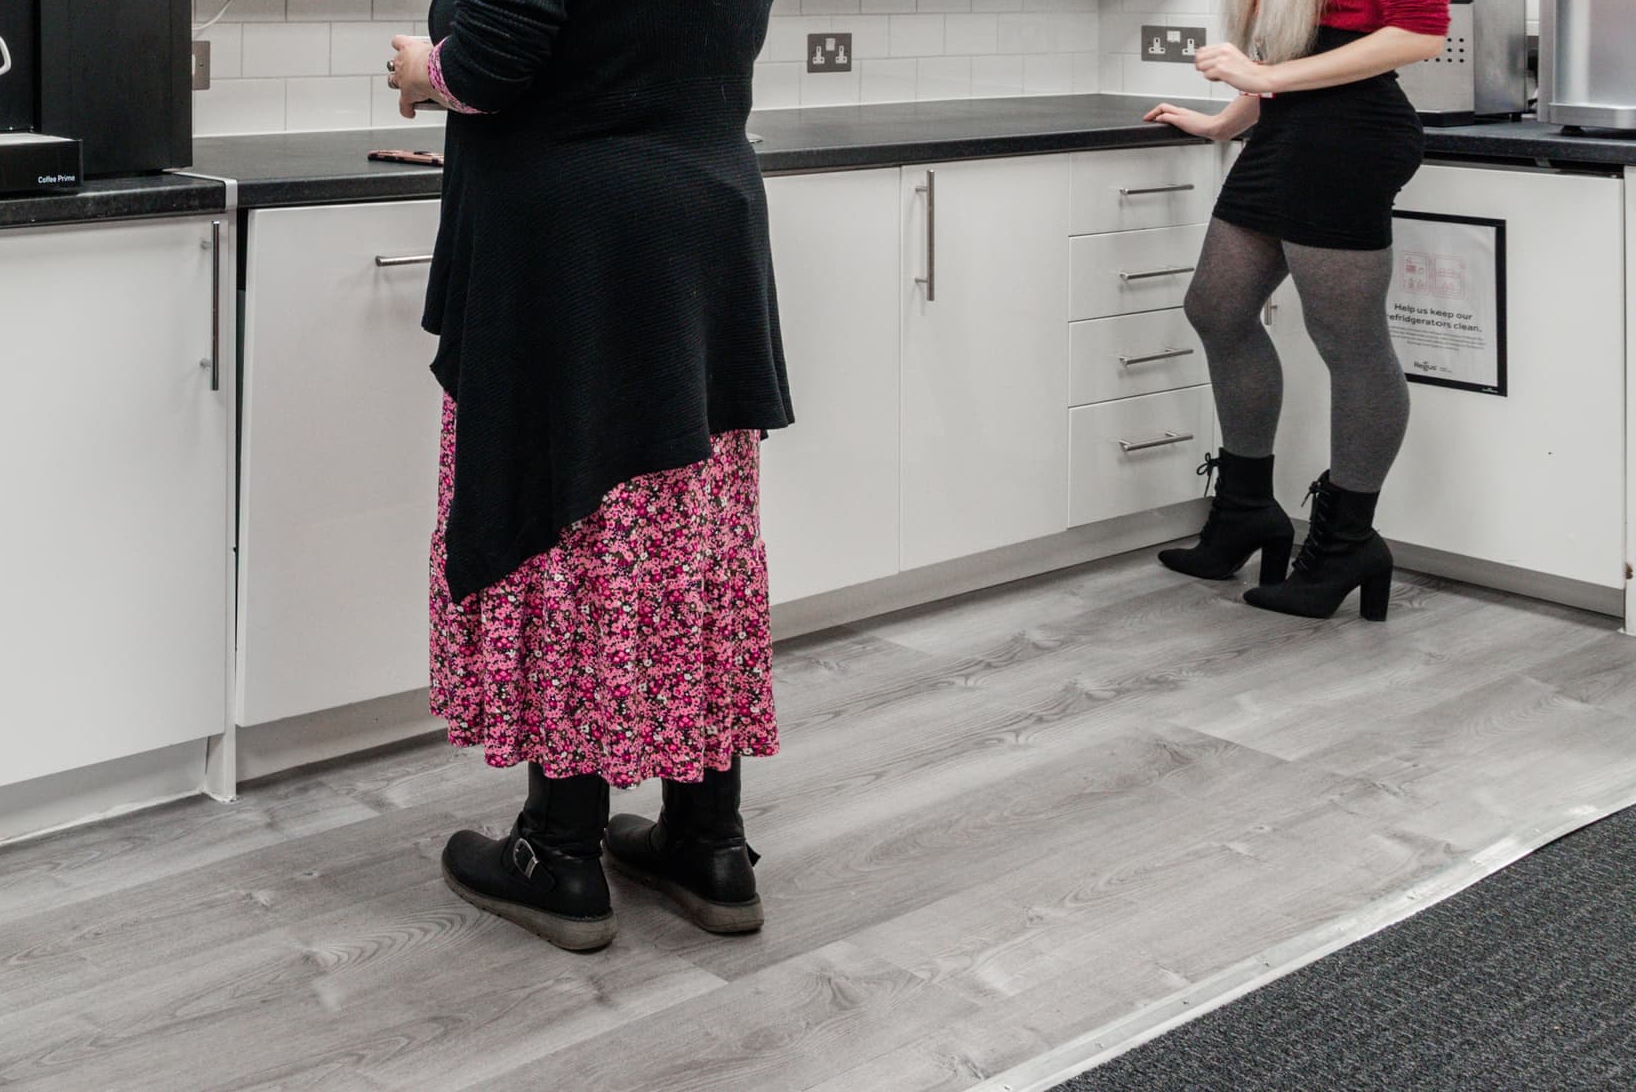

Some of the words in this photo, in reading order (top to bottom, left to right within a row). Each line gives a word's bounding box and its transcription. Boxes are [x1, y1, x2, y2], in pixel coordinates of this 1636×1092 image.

[38, 175, 57, 184] Coffee
[58, 173, 76, 182] Prime
[1394, 303, 1416, 314] Help
[1430, 308, 1454, 319] keep
[1453, 323, 1482, 333] clean.
